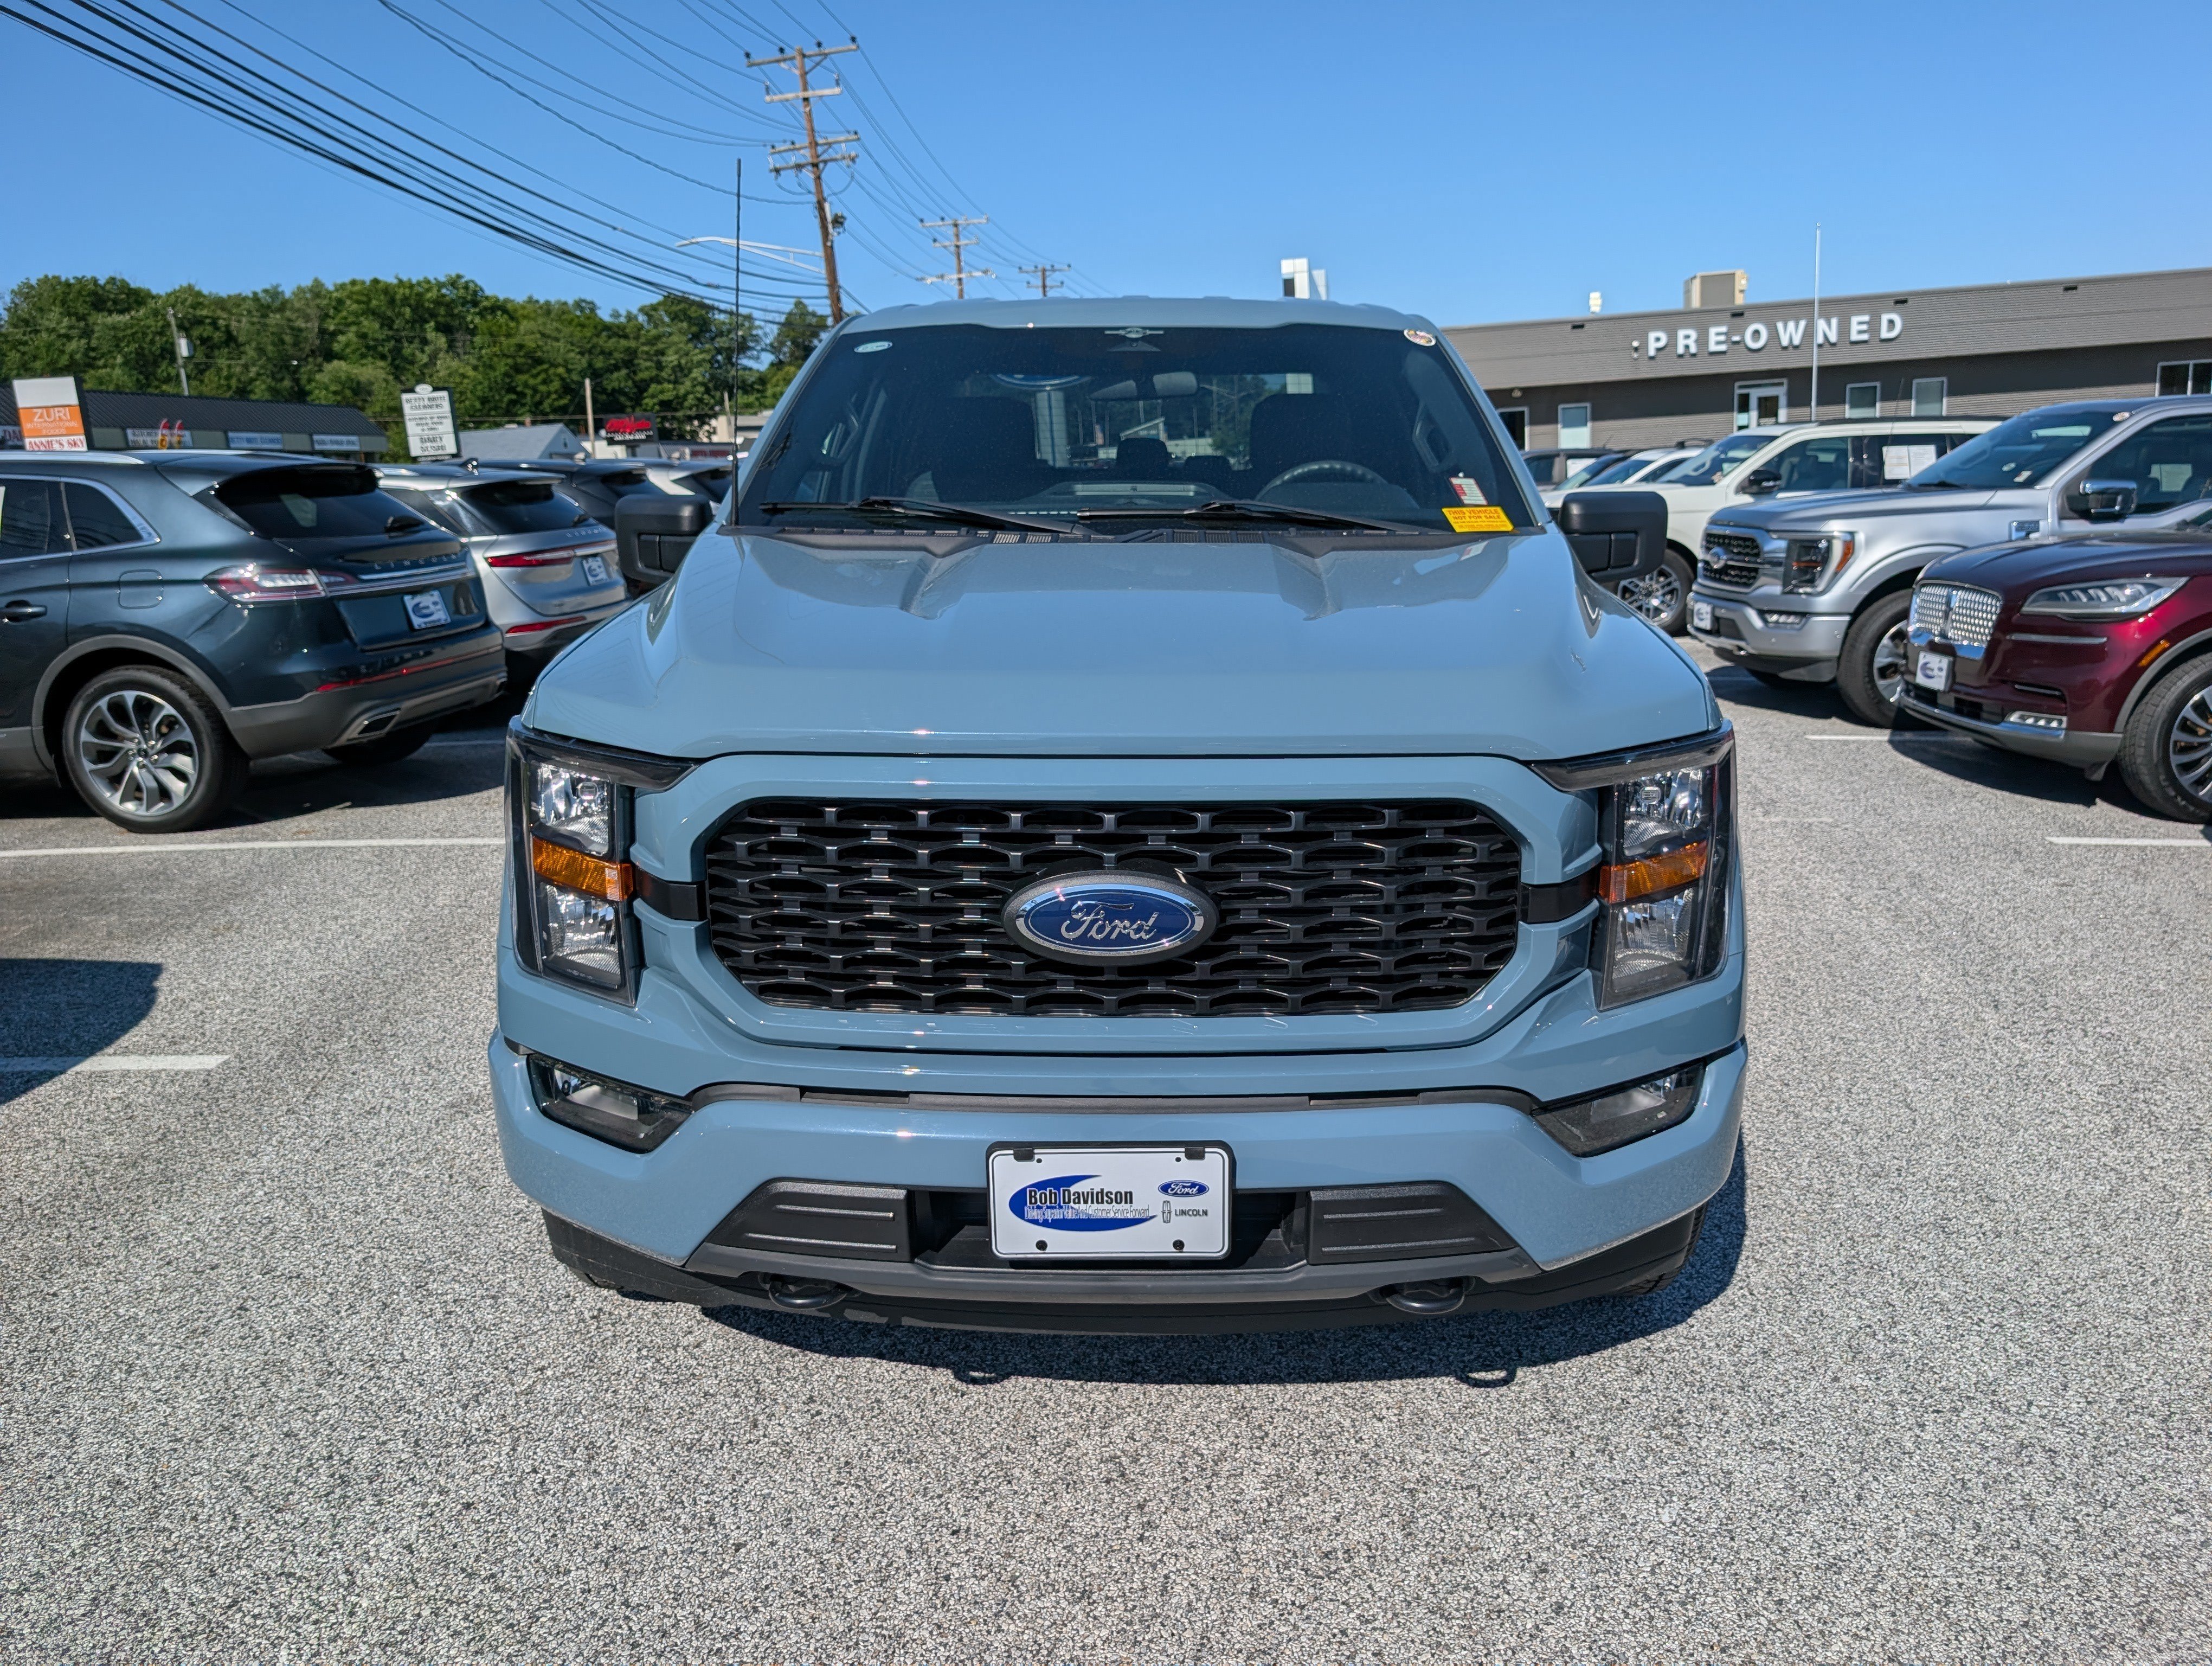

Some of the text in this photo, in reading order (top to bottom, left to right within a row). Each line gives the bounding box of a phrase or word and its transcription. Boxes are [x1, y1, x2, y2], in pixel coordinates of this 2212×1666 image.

[1647, 312, 1904, 358] PRE-OWNED
[33, 407, 70, 422] ZURI
[26, 420, 78, 428] INTERNATIONAL
[28, 438, 85, 451] ANNIE'S SKY
[1060, 900, 1159, 940] Ford
[1168, 1182, 1199, 1194] Ford
[1028, 1187, 1133, 1205] Bob Davidson
[1088, 1205, 1111, 1218] Customer
[1111, 1205, 1129, 1218] Service
[1129, 1204, 1149, 1218] Forward
[1174, 1208, 1208, 1216] LINCOLN
